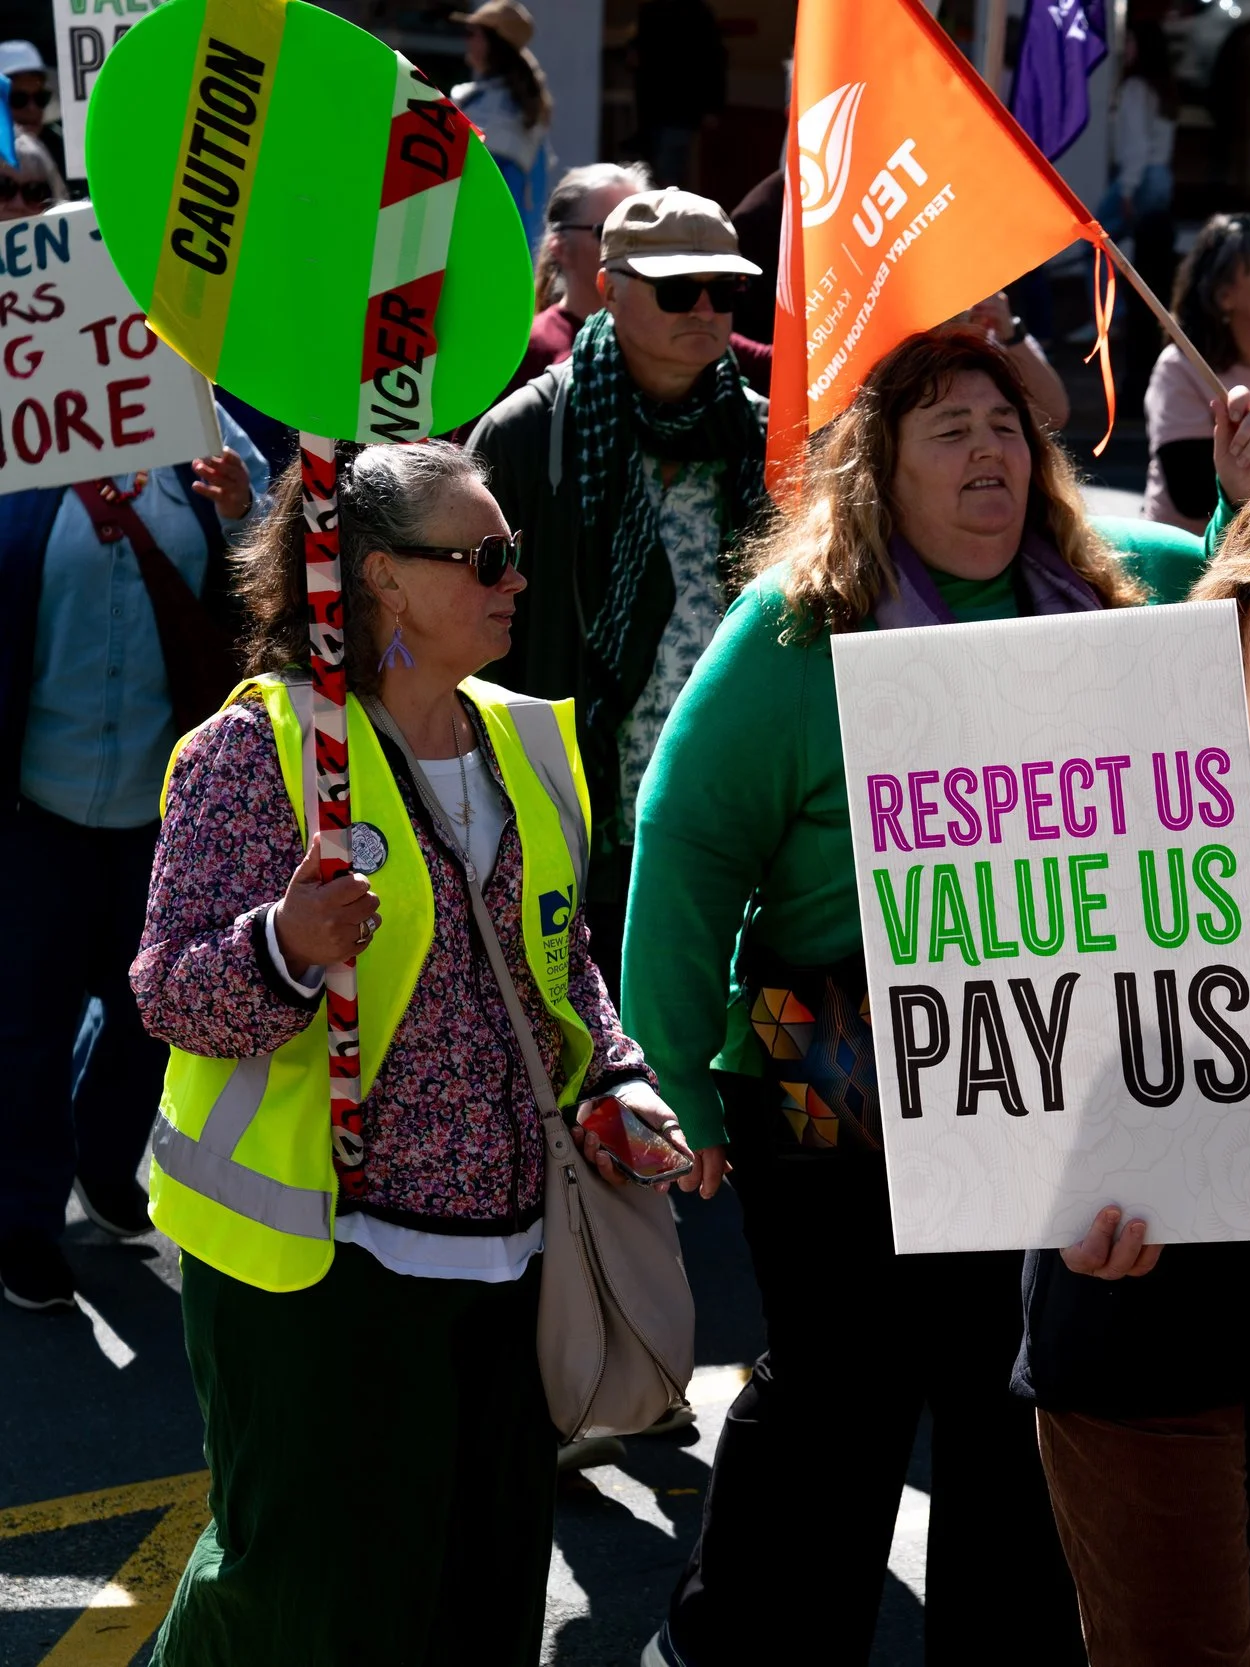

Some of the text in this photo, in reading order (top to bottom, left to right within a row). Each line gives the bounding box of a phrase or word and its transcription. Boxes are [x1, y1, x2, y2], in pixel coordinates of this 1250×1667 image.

[171, 37, 266, 276] CAUTION
[0, 217, 70, 277] EN
[79, 312, 158, 366] TO
[0, 376, 155, 470] ORE
[867, 747, 1235, 853] RESPECT US
[543, 938, 564, 950] NEW
[872, 844, 1242, 967] VALUE US
[545, 946, 569, 964] NU
[888, 972, 1081, 1119] PAY
